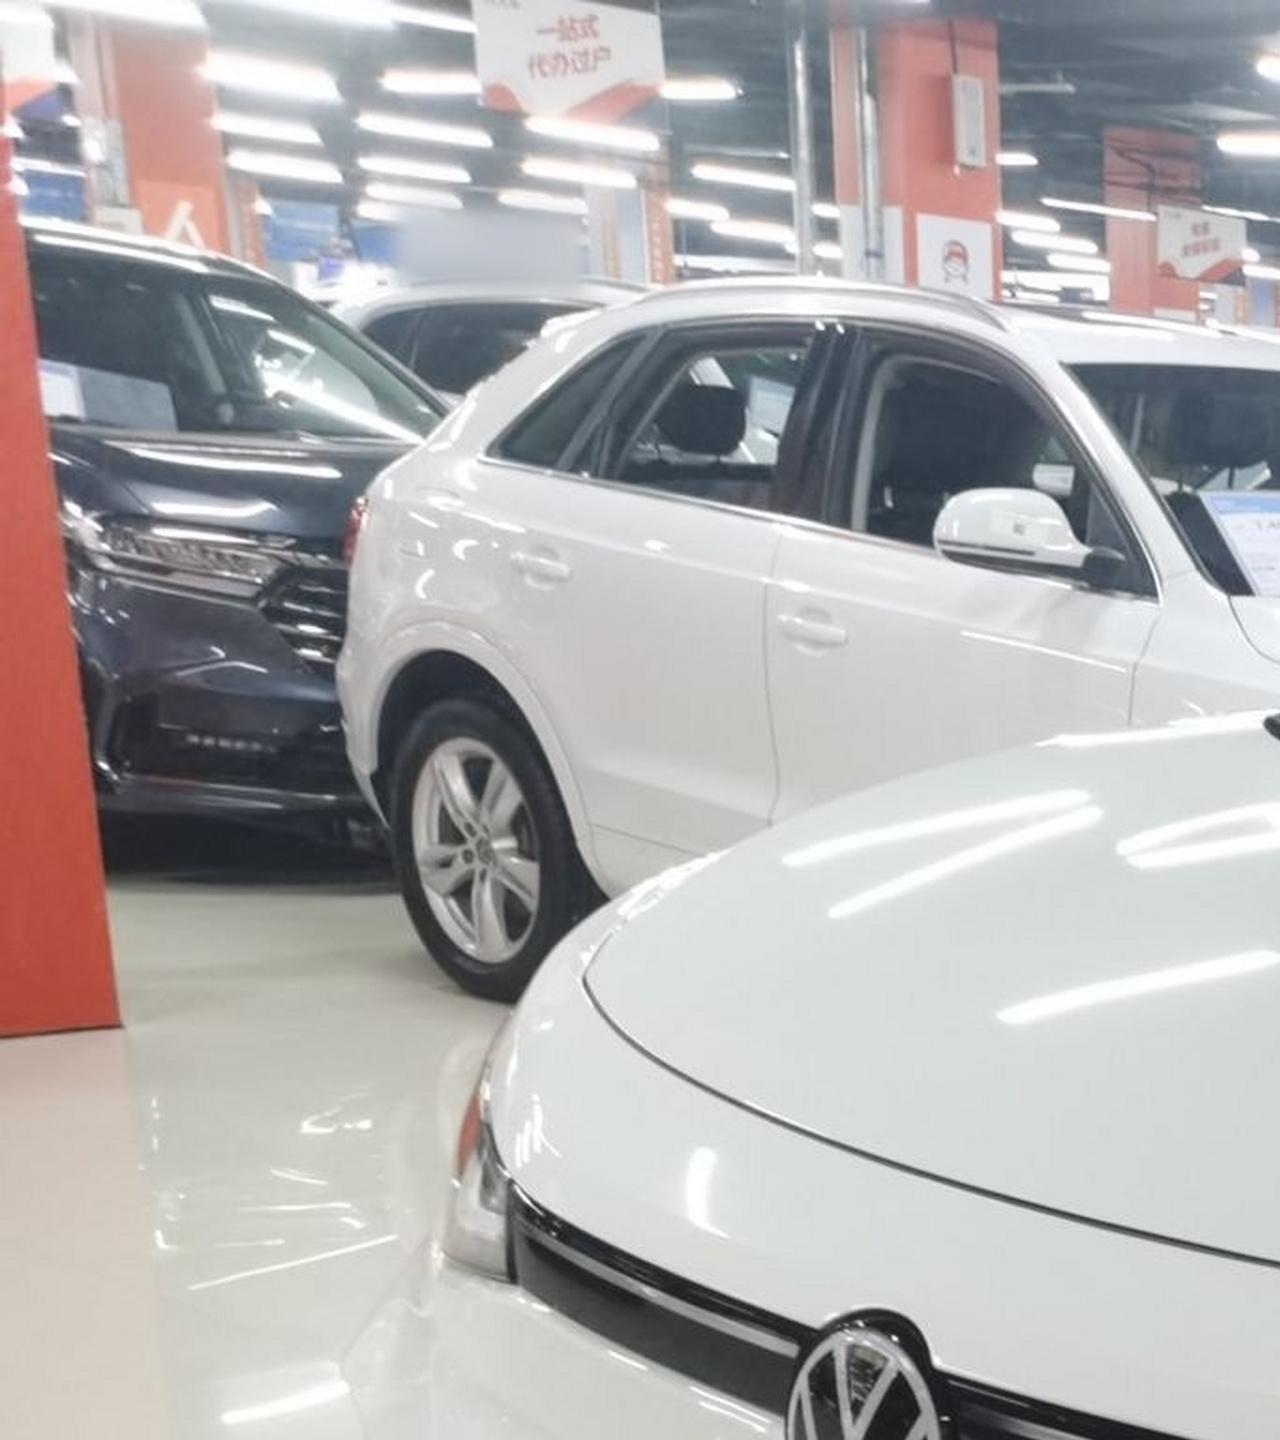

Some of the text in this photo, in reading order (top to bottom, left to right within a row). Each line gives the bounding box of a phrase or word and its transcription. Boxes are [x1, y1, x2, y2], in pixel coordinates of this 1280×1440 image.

[536, 14, 600, 42] 一站式
[528, 46, 612, 80] 代办过户
